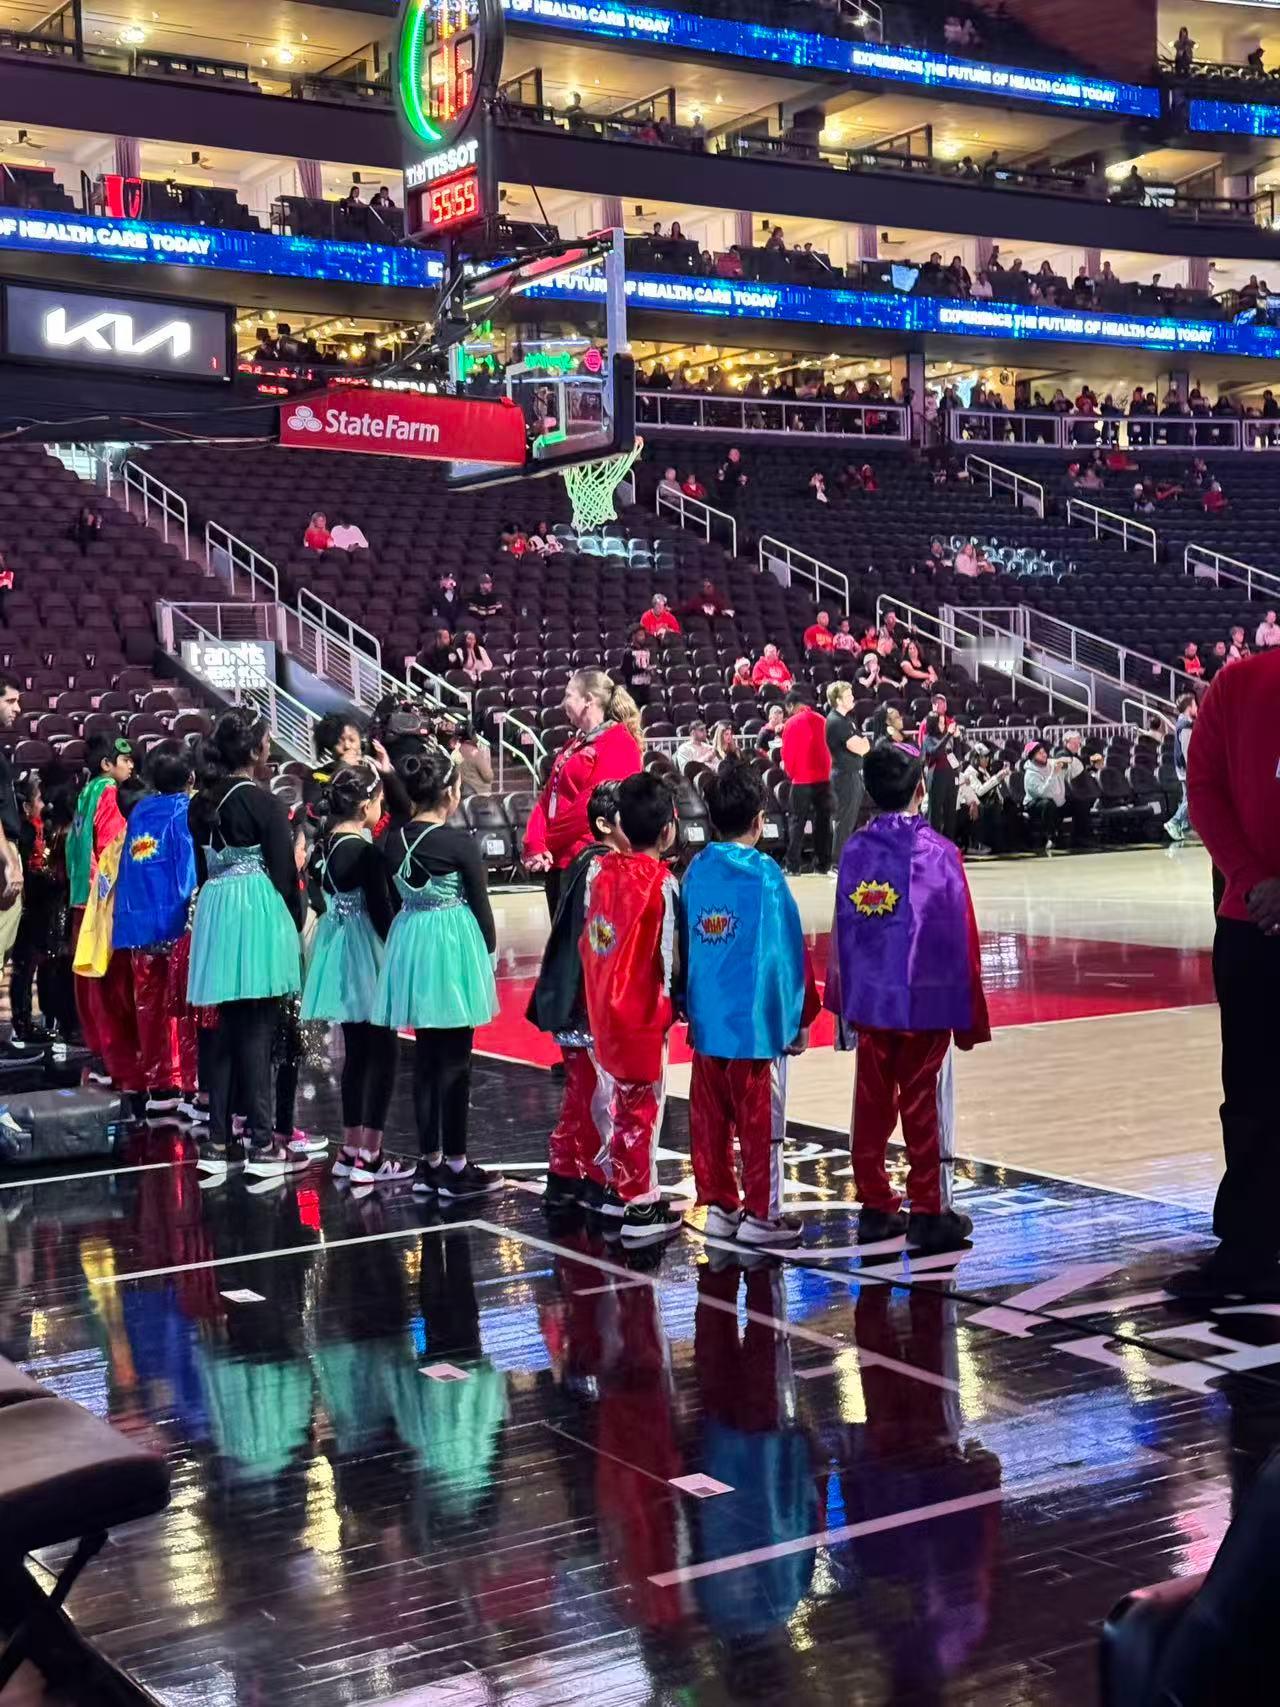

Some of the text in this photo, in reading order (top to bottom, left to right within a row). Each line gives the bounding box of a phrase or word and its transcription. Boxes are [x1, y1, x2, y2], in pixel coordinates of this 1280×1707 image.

[534, 0, 589, 20] HEALTH
[589, 8, 625, 27] CARE
[628, 14, 670, 34] TODAY
[948, 65, 991, 84] FUTURE
[992, 72, 1008, 86] OF
[1009, 74, 1051, 93] HEALTH
[1052, 81, 1080, 98] CARE
[1081, 85, 1115, 103] TODAY
[425, 140, 478, 179] TISSOT
[19, 220, 94, 243] HEALTH
[97, 228, 148, 249] CARE
[151, 233, 210, 254] TODAY
[638, 282, 692, 301] HEALTH
[694, 287, 731, 304] CARE
[734, 290, 777, 308] TODAY
[1038, 316, 1083, 333] FUTURE
[1084, 321, 1101, 334] OF
[1102, 321, 1146, 338] HEALTH
[1146, 325, 1175, 341] CARE
[1176, 328, 1212, 343] TODAY
